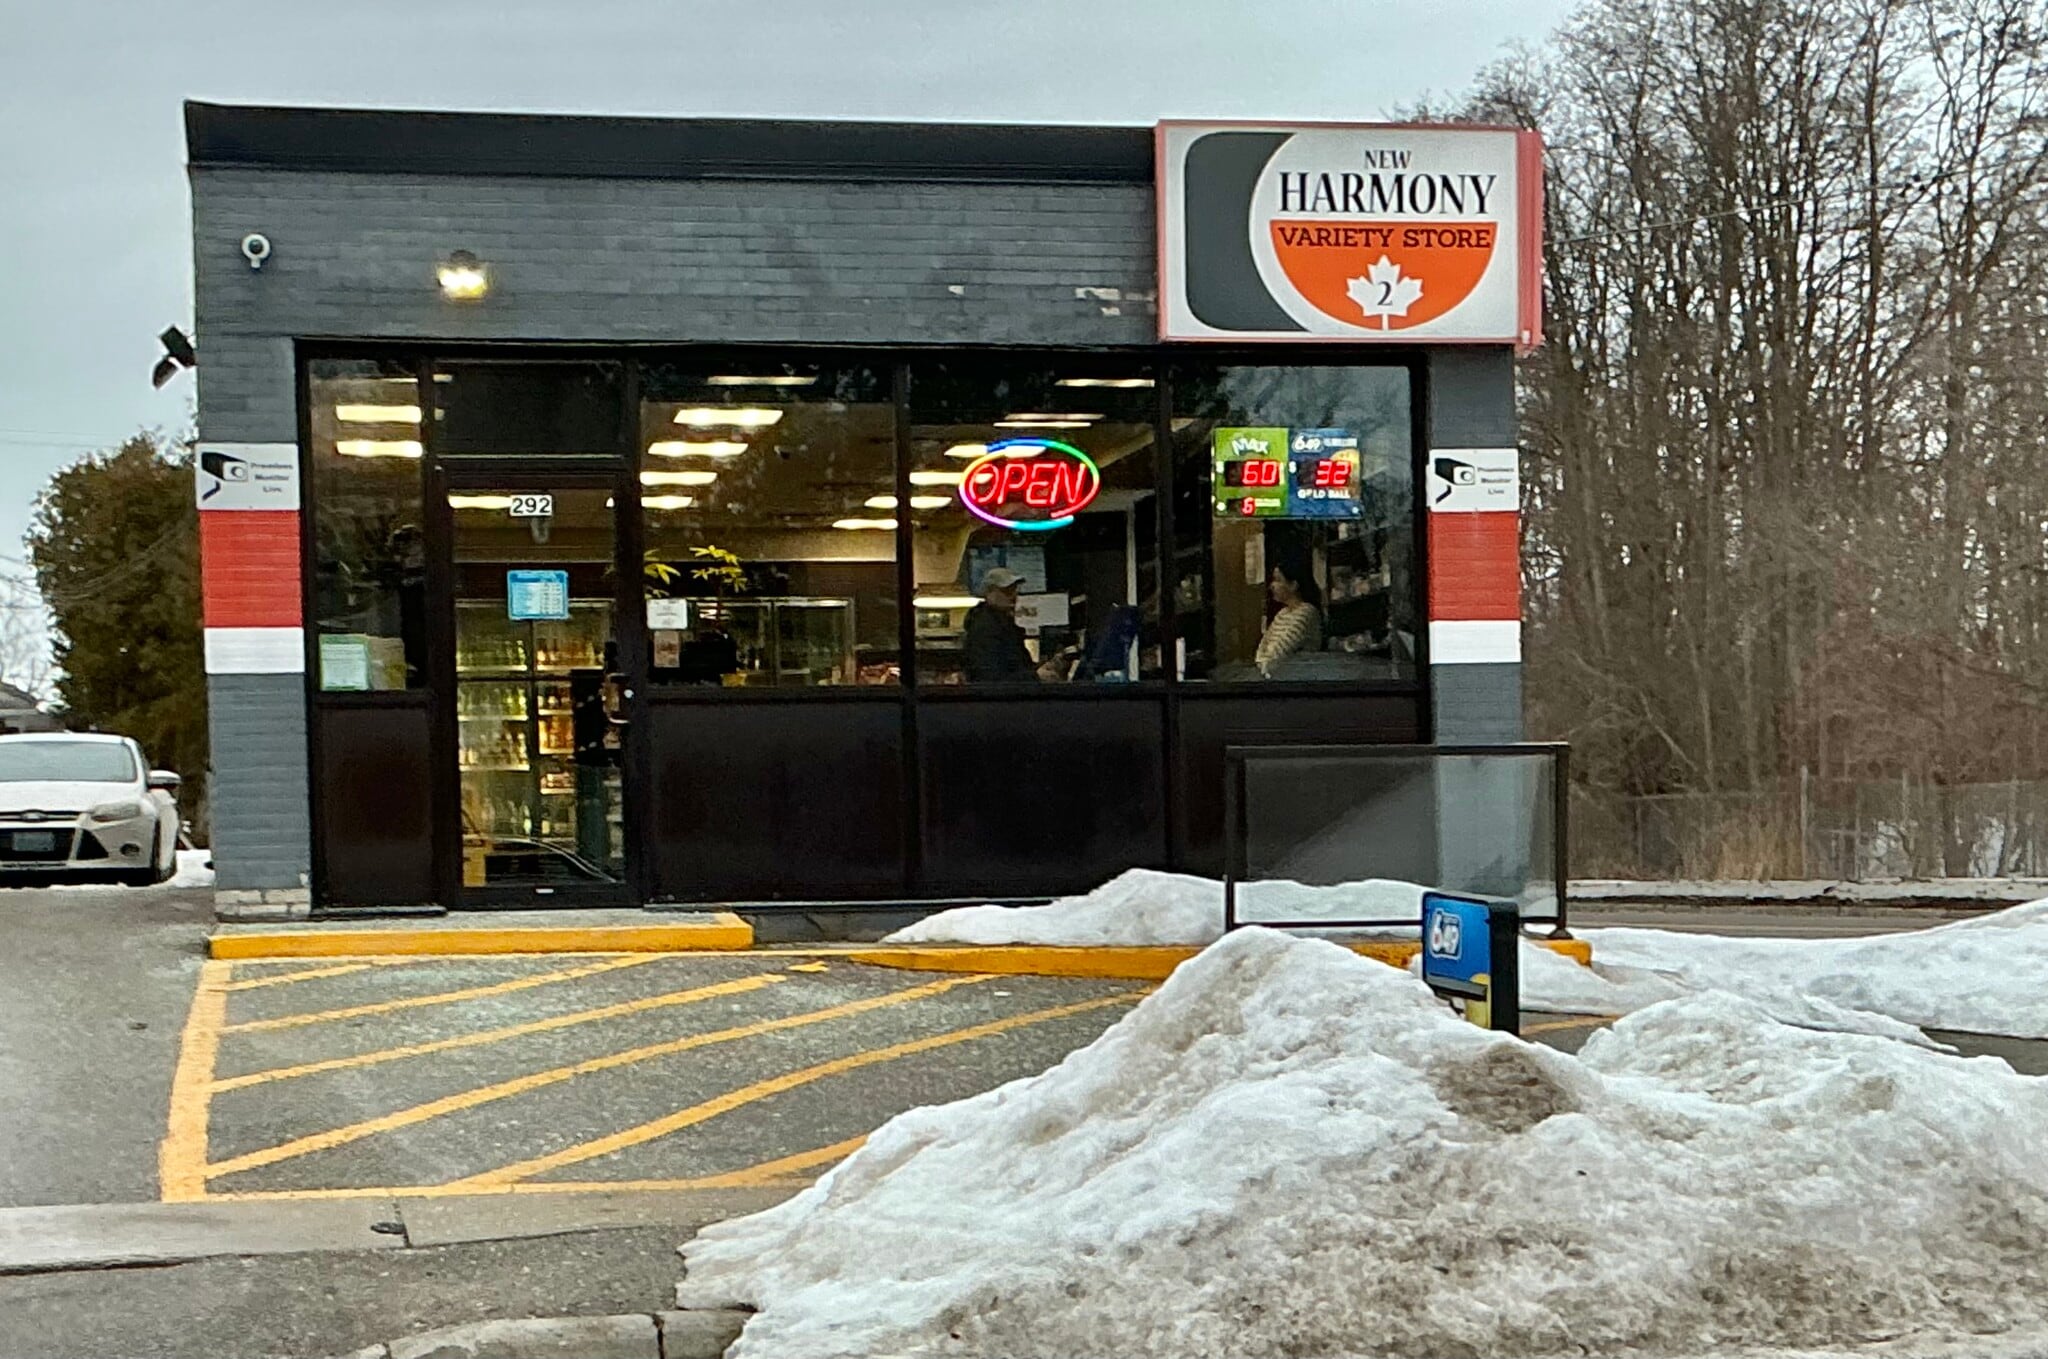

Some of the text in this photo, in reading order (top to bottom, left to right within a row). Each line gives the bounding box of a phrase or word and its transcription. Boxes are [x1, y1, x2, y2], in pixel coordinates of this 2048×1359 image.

[1364, 150, 1411, 169] NEW
[1279, 172, 1496, 215] HARMONY
[1279, 227, 1490, 249] VARIETY STORE
[1377, 281, 1393, 306] 2
[969, 463, 1086, 504] OPEN
[1242, 461, 1277, 485] 60
[1316, 461, 1349, 485] 32
[512, 497, 551, 513] 292
[1242, 497, 1254, 514] 6
